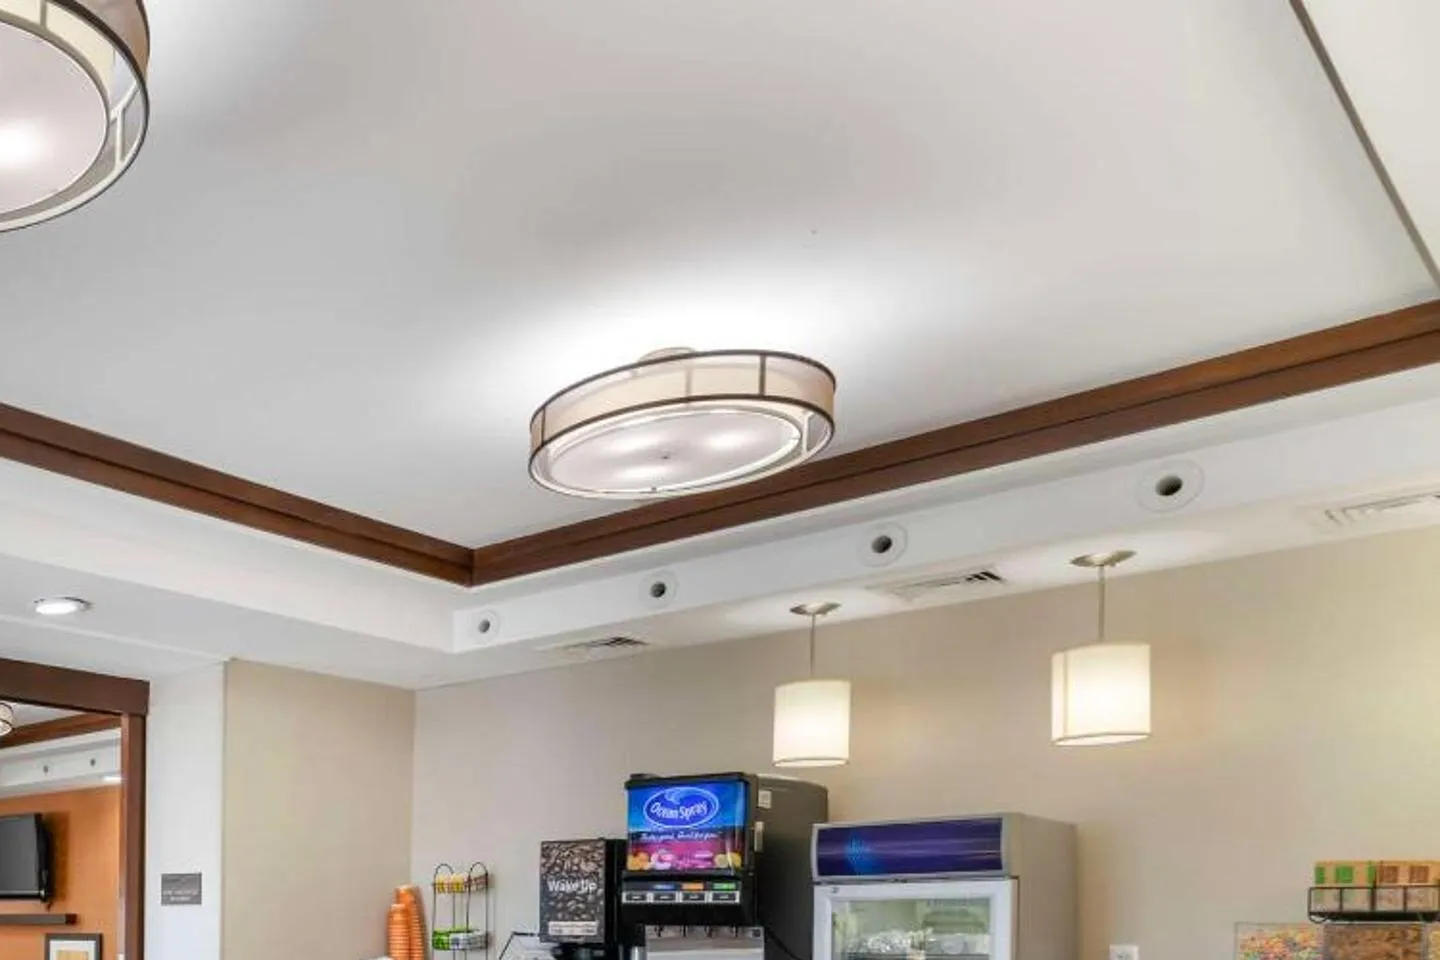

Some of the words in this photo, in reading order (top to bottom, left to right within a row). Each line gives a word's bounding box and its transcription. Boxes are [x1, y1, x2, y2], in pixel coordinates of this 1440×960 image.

[650, 802, 679, 819] Ocean
[680, 800, 709, 821] Spray
[547, 879, 579, 893] Wake
[581, 879, 598, 894] Up
